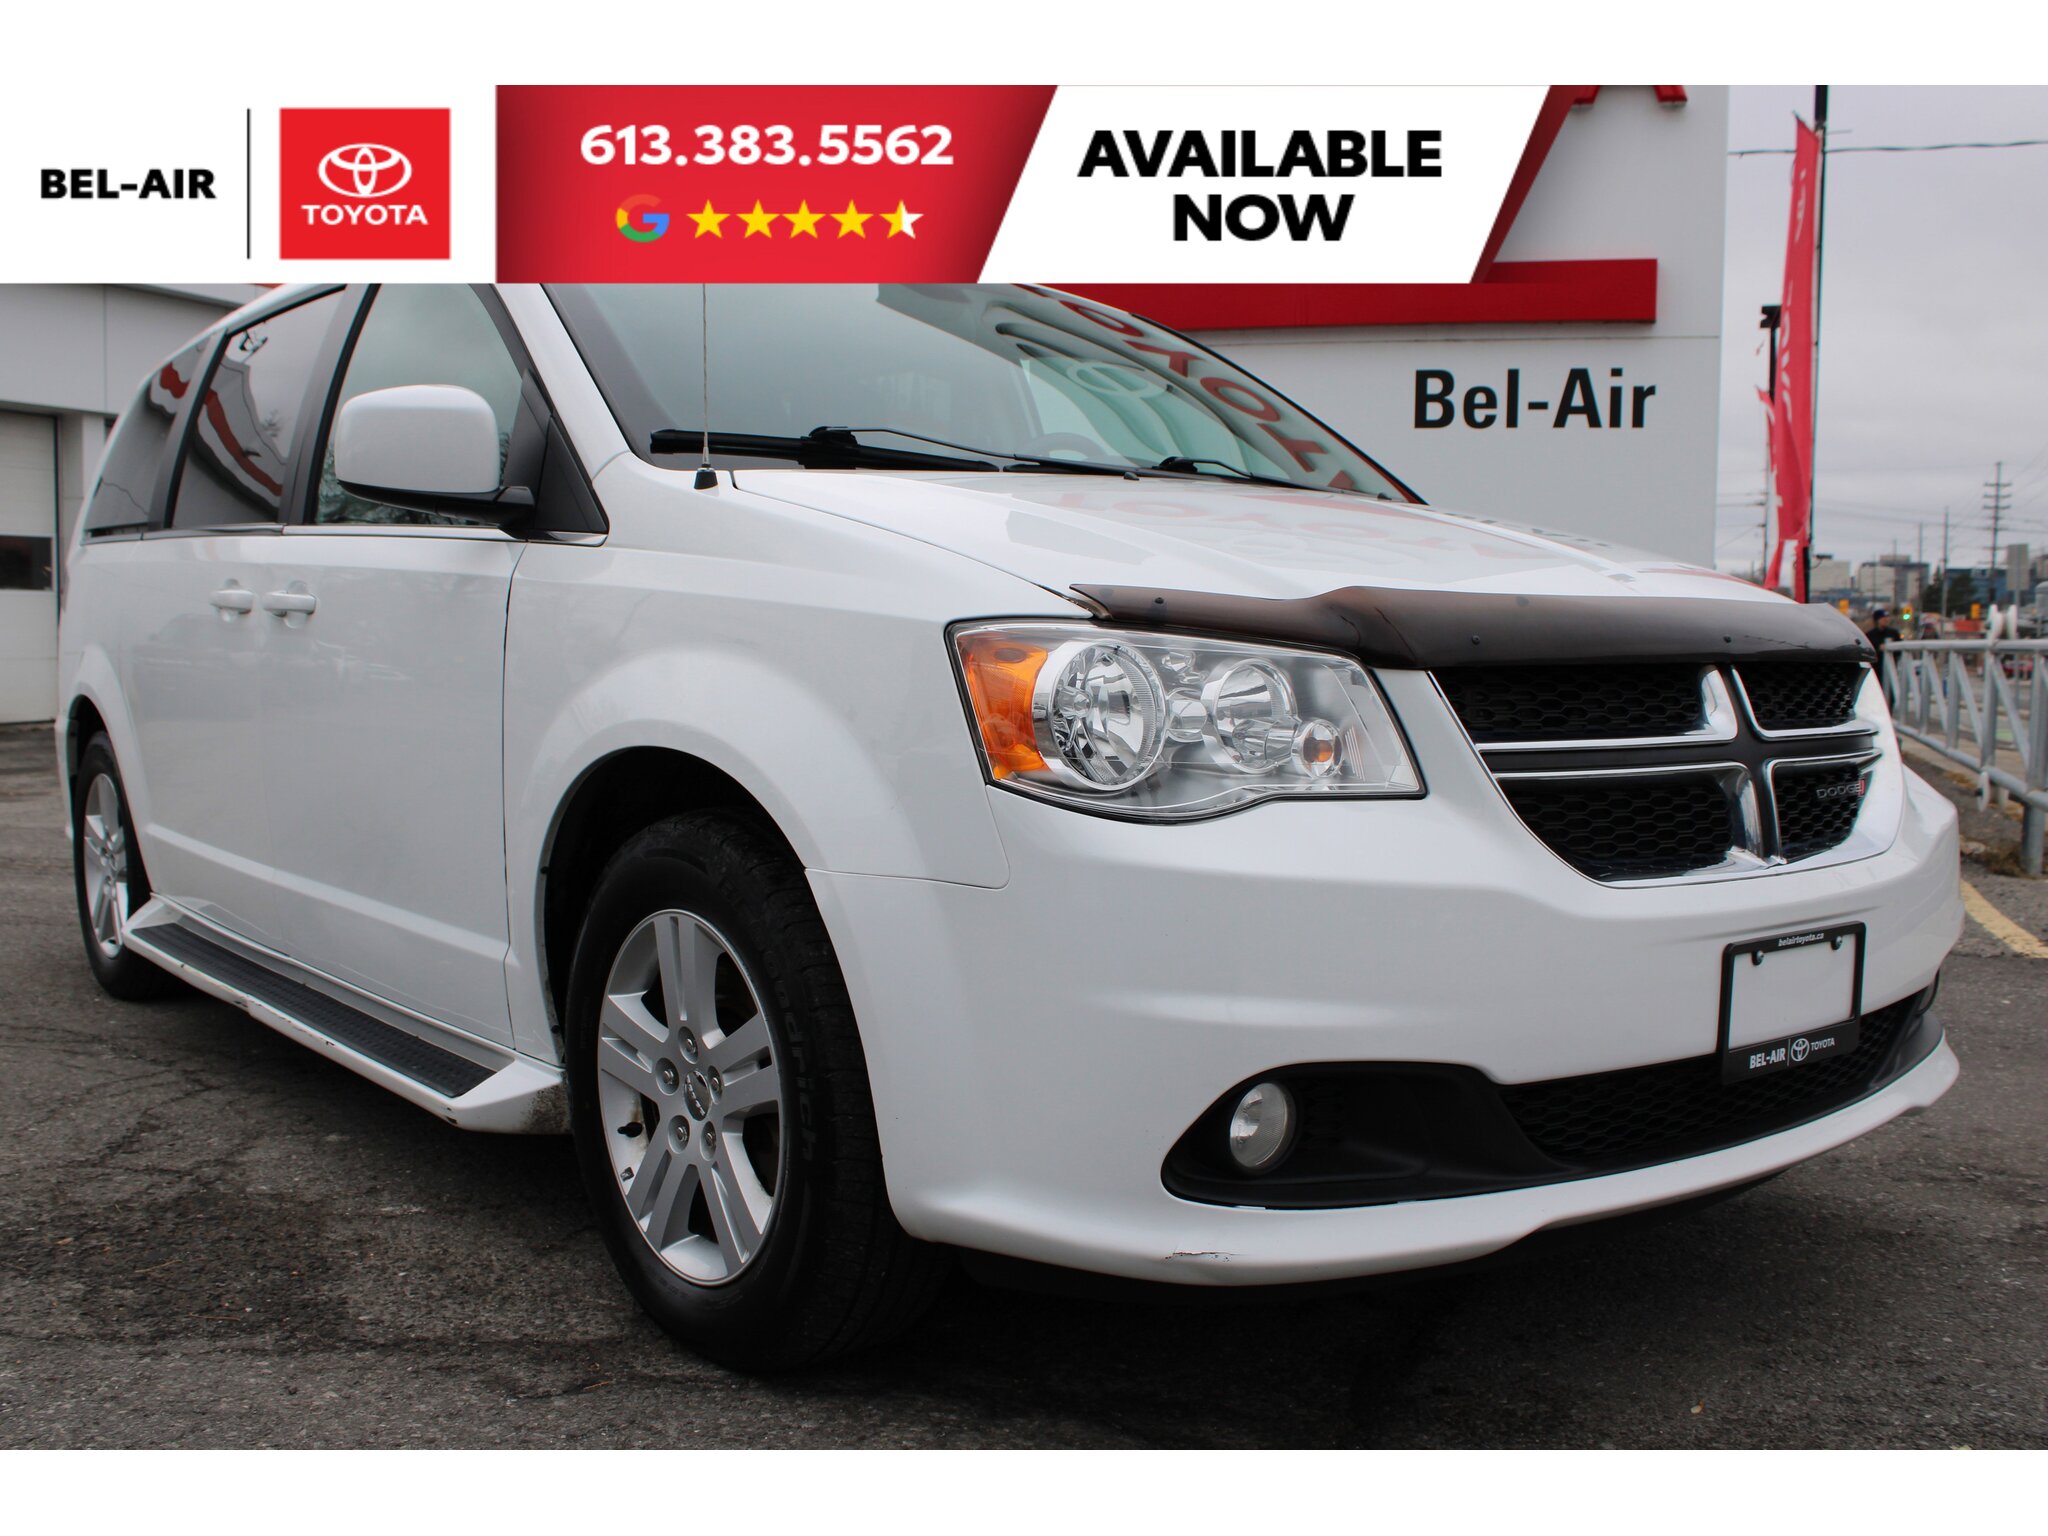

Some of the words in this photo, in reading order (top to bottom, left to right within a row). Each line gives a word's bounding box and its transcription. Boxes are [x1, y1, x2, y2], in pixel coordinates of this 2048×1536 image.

[1414, 367, 1656, 430] Bel-Air
[1816, 784, 1861, 798] DODGE
[1778, 932, 1825, 947] belairtoyota.ca
[1749, 1047, 1786, 1069] BEL-AIR
[1810, 1037, 1835, 1052] TOYOTA
